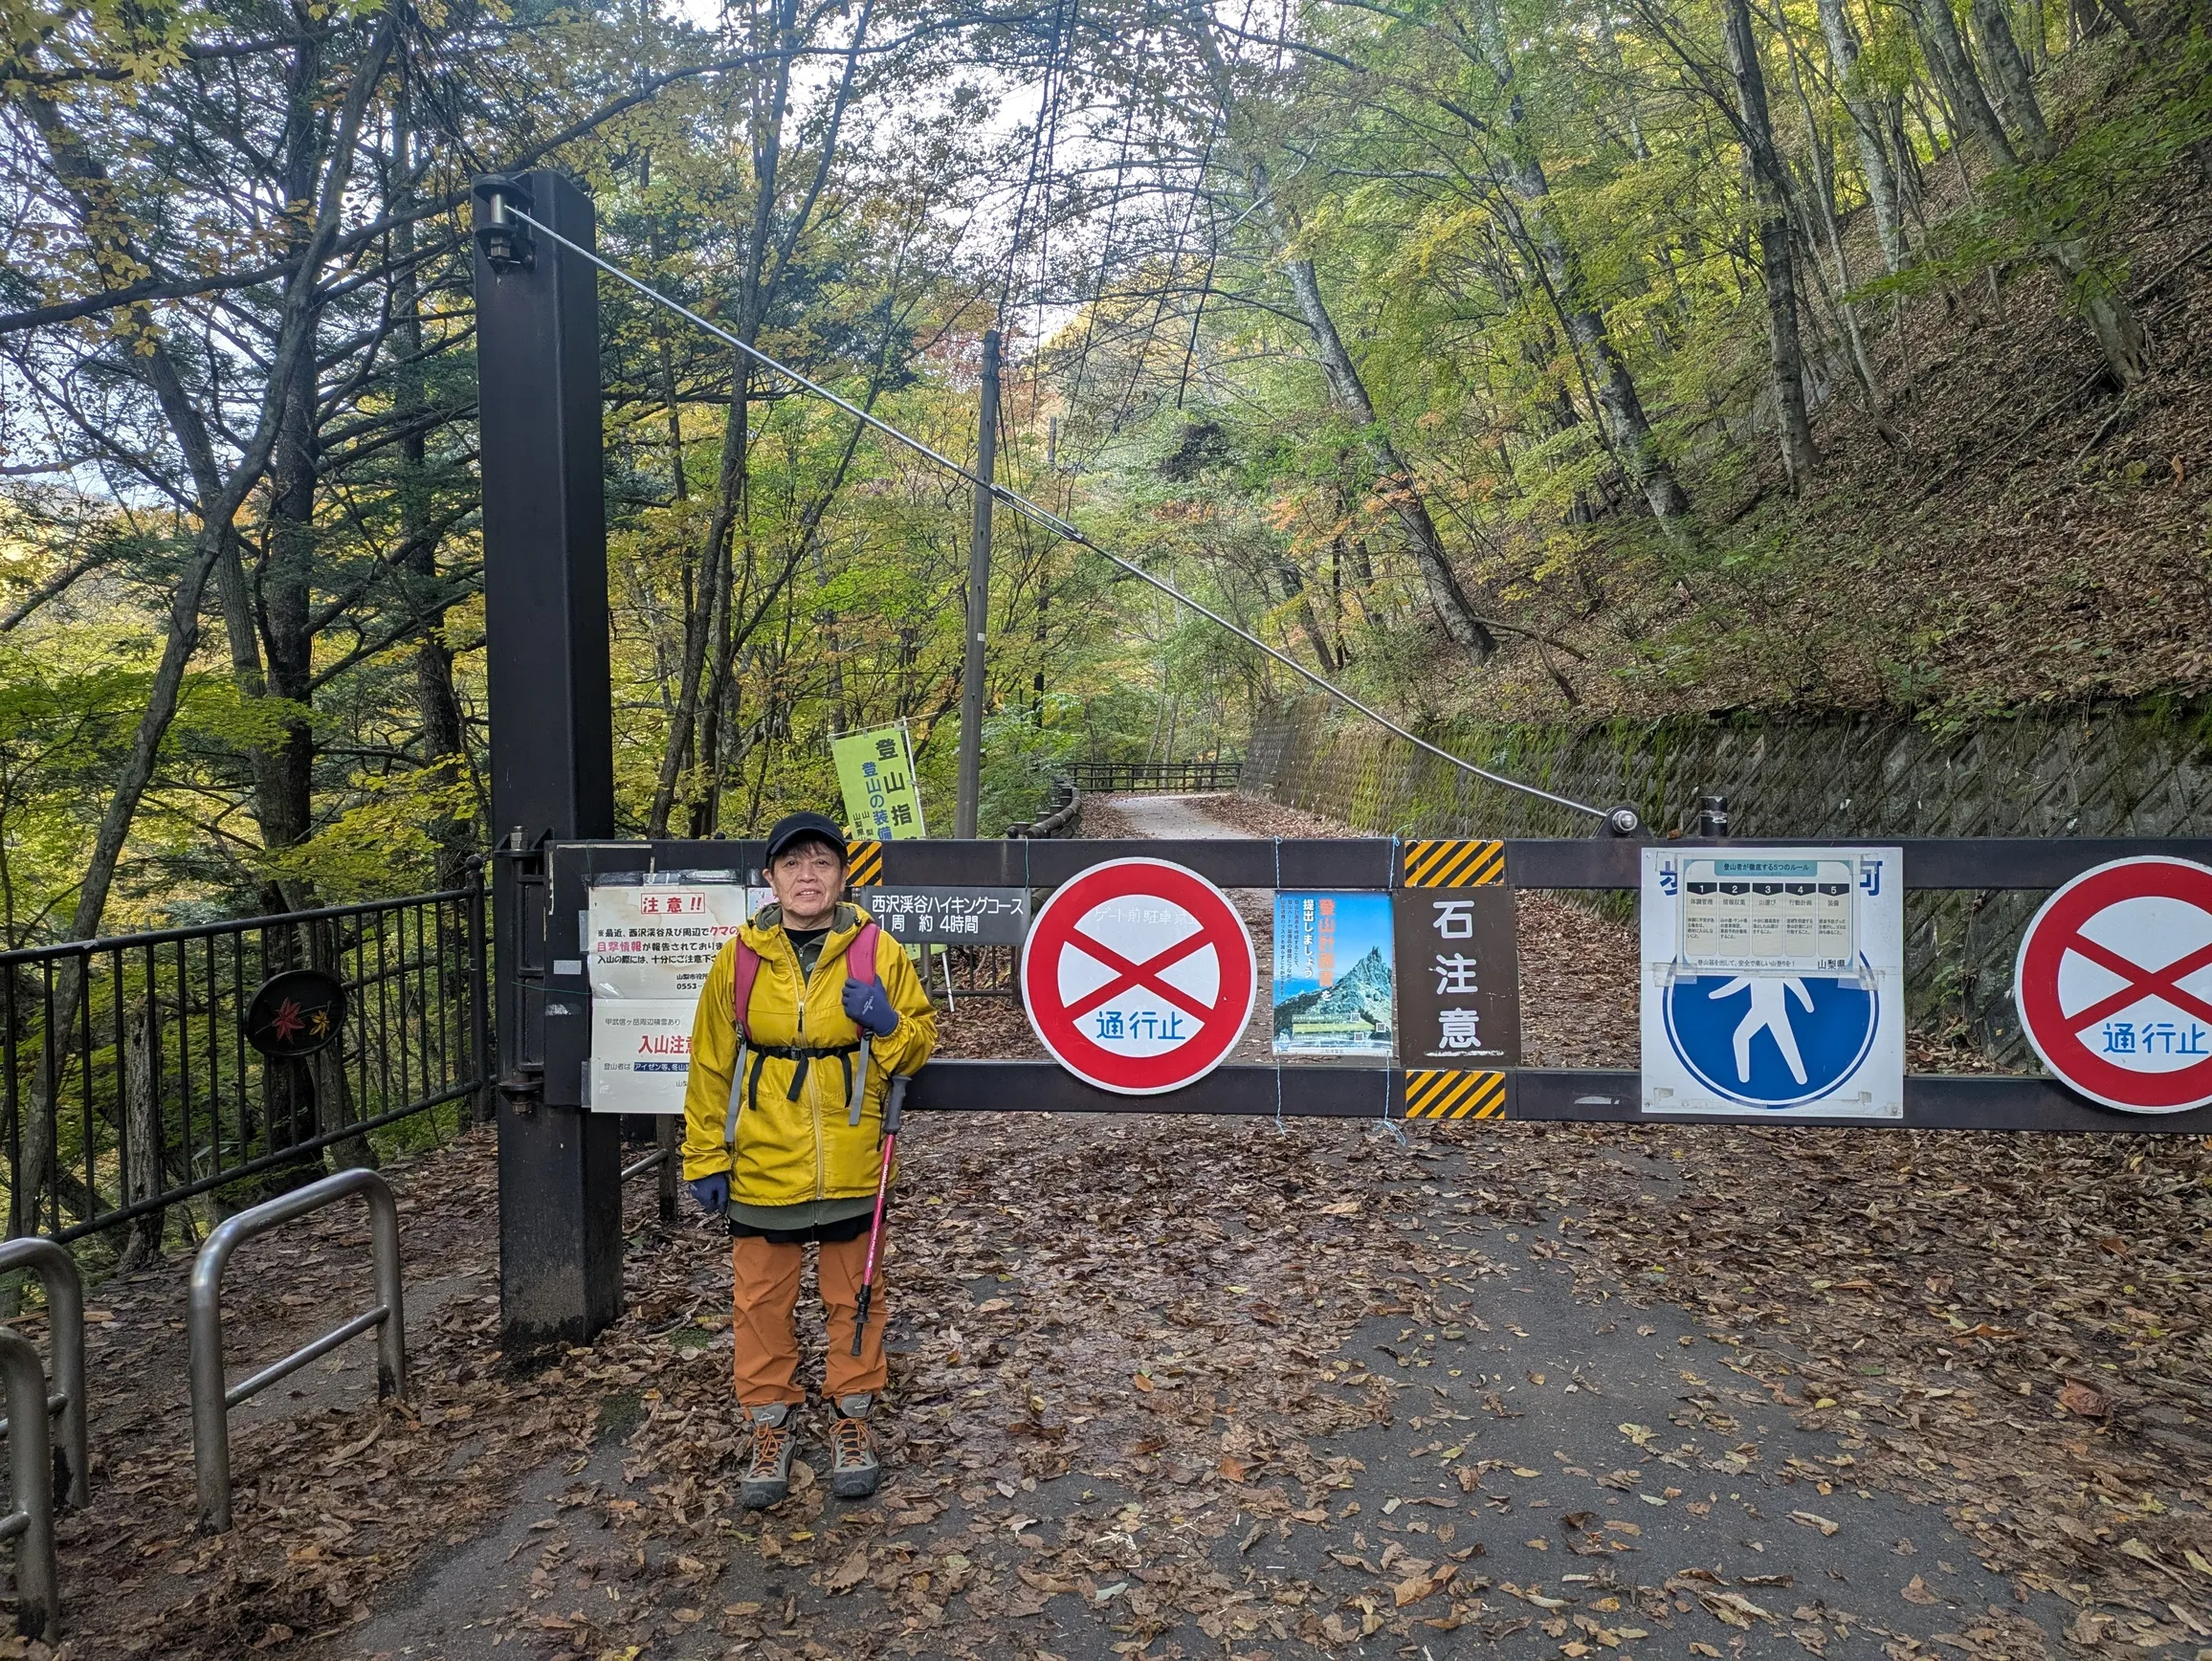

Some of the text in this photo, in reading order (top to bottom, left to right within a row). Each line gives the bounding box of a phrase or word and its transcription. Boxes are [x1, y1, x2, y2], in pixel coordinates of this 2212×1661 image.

[875, 738, 918, 840] 登山指
[1732, 885, 1738, 894] 2
[1765, 885, 1771, 895] 3
[1798, 885, 1804, 895] 4
[1830, 885, 1837, 895] 5
[872, 895, 1024, 915] 西沢渓谷ハイキングコース
[918, 915, 934, 933] 約
[939, 915, 979, 934] 4時間
[1302, 898, 1315, 978] 提出しましょう
[1818, 960, 1847, 970] 山梨県
[1096, 1010, 1186, 1040] 通行止
[2102, 1022, 2210, 1054] 通行止
[604, 1062, 631, 1071] 登山者は
